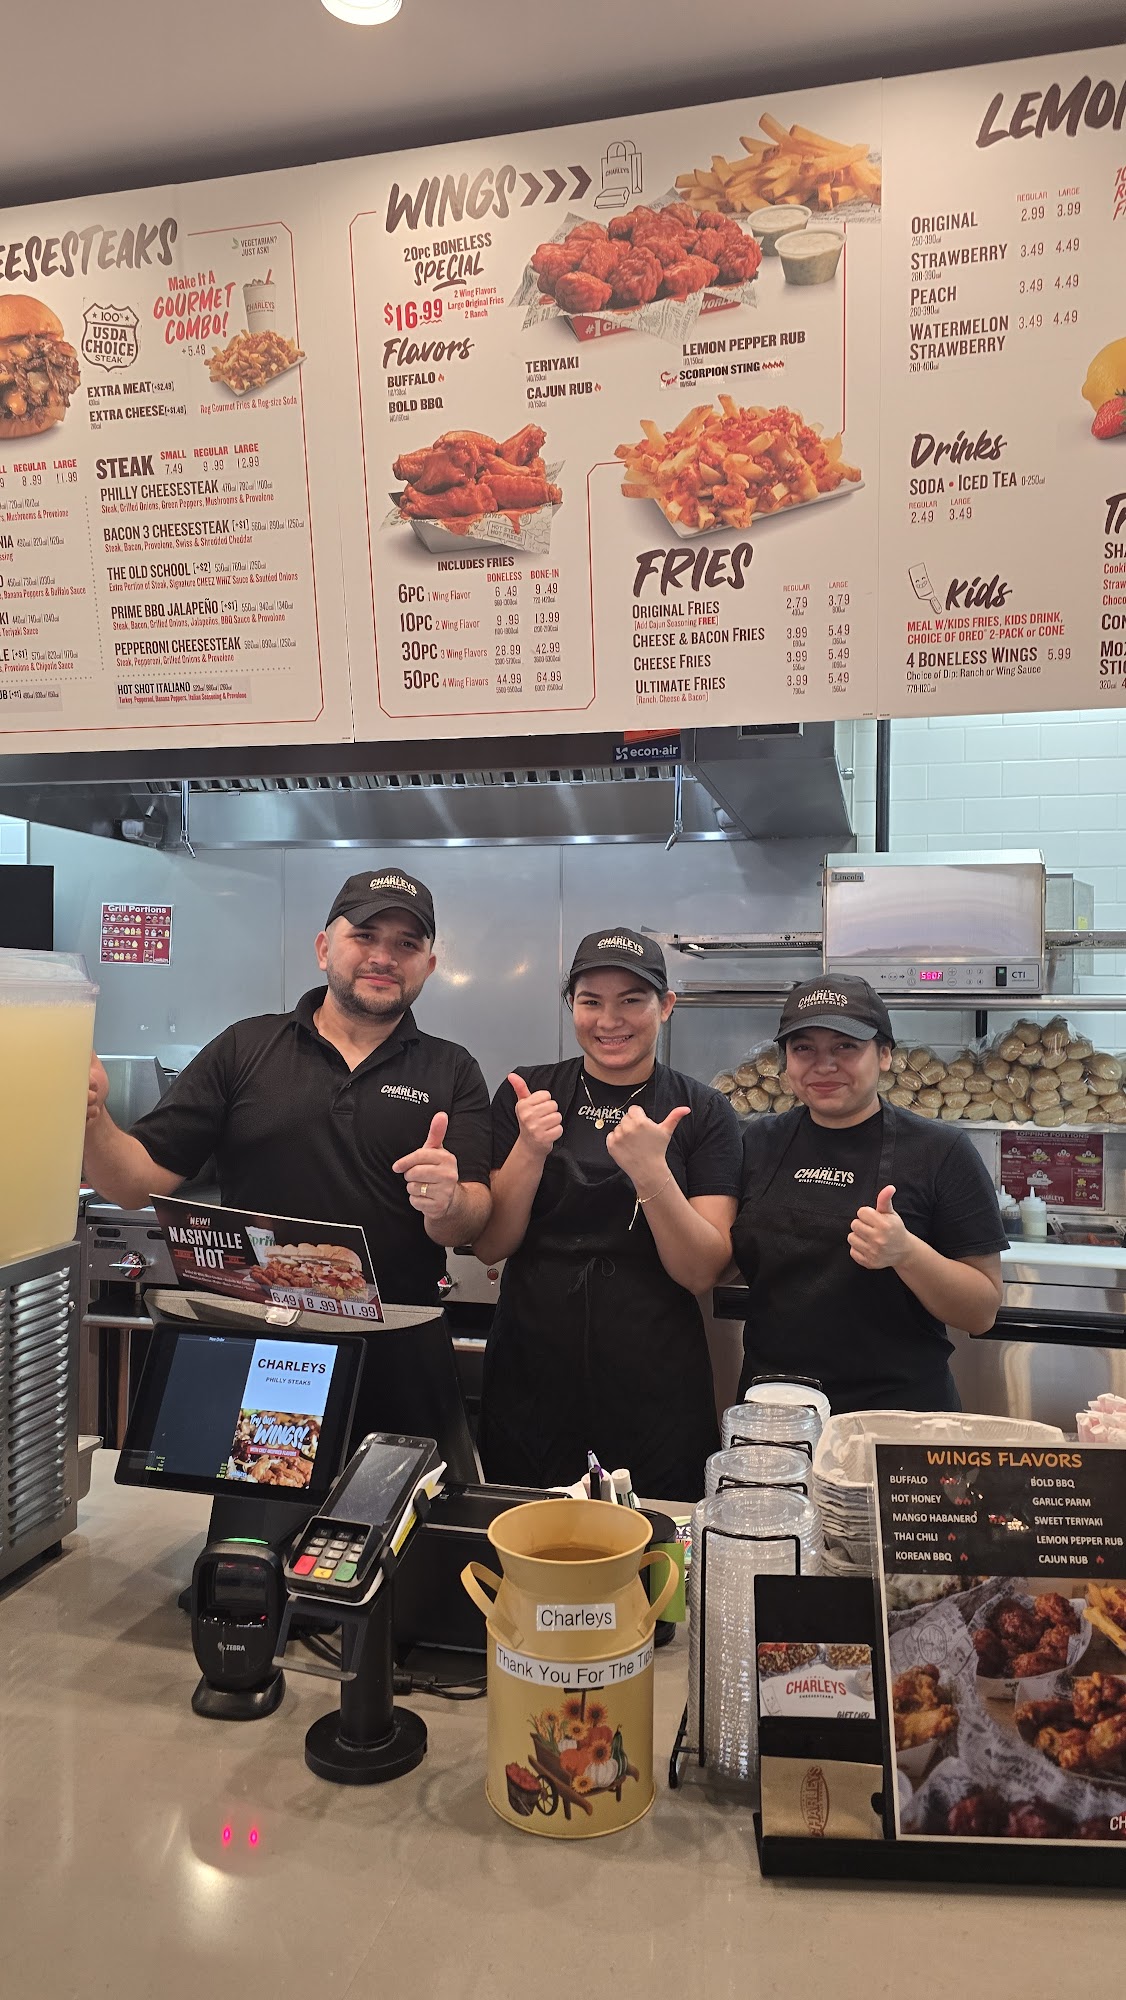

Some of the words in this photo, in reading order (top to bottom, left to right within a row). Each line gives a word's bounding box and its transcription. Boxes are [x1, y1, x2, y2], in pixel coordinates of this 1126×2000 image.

[386, 165, 516, 233] WINGS
[1021, 206, 1045, 222] 2.99
[1057, 202, 1081, 217] 3.99
[911, 211, 978, 235] ORIGINAL
[241, 236, 277, 248] VEGETARIAN?
[433, 232, 492, 257] BONELESS
[241, 247, 256, 257] JUST
[911, 243, 1008, 270] STRAWBERRY
[414, 252, 484, 286] SPECIAL
[168, 274, 196, 291] Make
[198, 272, 206, 285] It
[208, 271, 215, 283] A
[153, 282, 236, 319] GOURMET
[459, 288, 474, 298] Wing
[475, 287, 496, 296] Flavors
[911, 286, 957, 306] PEACH
[448, 301, 464, 310] Large
[465, 299, 488, 308] Original
[489, 297, 504, 306] Fries
[384, 299, 443, 330] $16.99
[465, 311, 468, 319] 2
[470, 309, 488, 318] Ranch
[93, 327, 127, 341] USDA
[165, 311, 228, 344] COMBO!
[910, 315, 1009, 340] WATERMELON
[85, 339, 134, 357] CHOICE
[683, 340, 725, 356] LEMON
[729, 334, 777, 352] PEPPER
[780, 331, 805, 345] RUB
[910, 335, 1005, 361] STRAWBERRY
[95, 354, 123, 364] STEAK
[383, 337, 474, 369] Flavors
[526, 357, 579, 374] TERIYAKI
[680, 365, 728, 381] SCORPION
[731, 362, 760, 374] STING
[387, 372, 435, 388] BUFFALO
[527, 384, 566, 400] CAJUN
[569, 382, 593, 396] RUB
[89, 409, 123, 422] EXTRA
[125, 405, 165, 420] CHEESE
[388, 399, 417, 413] BOLD
[420, 397, 443, 411] BBQ
[910, 430, 1008, 468] Drinks
[96, 455, 155, 480] STEAK
[160, 450, 186, 461] SMALL
[194, 445, 229, 458] REGULAR
[234, 443, 259, 454] LARGE
[165, 463, 183, 474] 7.49
[237, 456, 259, 469] 12.99
[101, 484, 138, 501] PHILLY
[141, 480, 219, 498] CHEESESTEAK
[910, 477, 945, 496] SODA
[958, 474, 988, 492] ICED
[992, 471, 1018, 488] TEA
[107, 567, 126, 581] THE
[129, 565, 148, 579] OLD
[150, 563, 191, 577] SCHOOL
[438, 558, 484, 571] INCLUDES
[487, 557, 514, 568] FRIES
[632, 542, 754, 597] FRIES
[399, 583, 425, 603] 6PC
[945, 574, 1012, 610] Kids
[112, 605, 143, 619] PRIME
[145, 602, 165, 618] BBQ
[167, 598, 218, 616] JALAPEÑO
[907, 620, 932, 632] MEAL
[934, 617, 970, 631] W/KIDS
[972, 616, 1002, 630] FRIES,
[1004, 614, 1027, 626] KIDS
[1030, 612, 1064, 626] DRINK,
[633, 633, 675, 648] CHEESE
[679, 633, 688, 645] &
[691, 630, 729, 644] BACON
[733, 627, 765, 642] FRIES
[402, 641, 438, 661] 30PC
[495, 645, 521, 655] 28.99
[536, 642, 560, 654] 42.99
[906, 653, 915, 668] 4
[918, 650, 988, 668] BONELESS
[992, 646, 1038, 664] WINGS
[1048, 648, 1071, 660] 5.99
[906, 669, 932, 681] Choice
[934, 668, 942, 678] of
[943, 667, 958, 680] Dip:
[960, 666, 984, 678] Ranch
[986, 666, 994, 676] or
[996, 666, 1016, 677] Wing
[1017, 664, 1041, 675] Sauce
[118, 684, 133, 695] HOT
[134, 683, 154, 694] SHOT
[155, 681, 191, 693] ITALIANO
[834, 873, 862, 881] Lincoln
[370, 877, 417, 895] CHARLEYS
[597, 938, 644, 954] CHARLEYS
[798, 993, 847, 1008] CHARLEYS
[381, 1085, 429, 1103] CHARLEYS
[578, 1106, 627, 1119] CHARLE
[794, 1169, 854, 1184] CHARLEYS
[190, 1217, 210, 1226] NEW!
[168, 1226, 242, 1249] NASHVILLE
[194, 1247, 224, 1269] HOT
[272, 1292, 297, 1306] 6.49
[343, 1304, 376, 1318] 11.99
[258, 1358, 326, 1374] CHARLEYS
[266, 1376, 286, 1385] PHILLY
[287, 1378, 311, 1386] STEAKS
[253, 1424, 309, 1449] WINGS!
[927, 1451, 991, 1466] WINGS
[998, 1452, 1083, 1468] FLAVORS
[890, 1475, 928, 1484] BUFFALO
[1030, 1478, 1053, 1487] BOLD
[1056, 1479, 1075, 1489] BBQ
[891, 1494, 909, 1503] HOT
[911, 1494, 941, 1504] HONEY
[1032, 1497, 1064, 1506] GARLIC
[1065, 1498, 1091, 1507] PARM
[893, 1513, 927, 1522] MANGO
[929, 1514, 977, 1523] HABANERO
[1035, 1516, 1063, 1526] SWEET
[1065, 1517, 1103, 1526] TERIYAKI
[894, 1532, 915, 1541] THAI
[917, 1532, 938, 1542] CHILI
[1037, 1536, 1069, 1545] LEMON
[1071, 1536, 1103, 1546] PEPPER
[1104, 1537, 1124, 1546] RUB
[896, 1551, 931, 1561] KOREAN
[933, 1553, 952, 1563] BBQ
[1039, 1555, 1067, 1564] CAJUN
[1069, 1555, 1088, 1565] RUB
[541, 1609, 612, 1629] Charleys
[226, 1644, 246, 1652] ZEBRA
[498, 1647, 533, 1678] Thank
[539, 1664, 570, 1684] You
[577, 1668, 604, 1684] For
[609, 1661, 634, 1679] The
[786, 1680, 846, 1695] CHARLEYS
